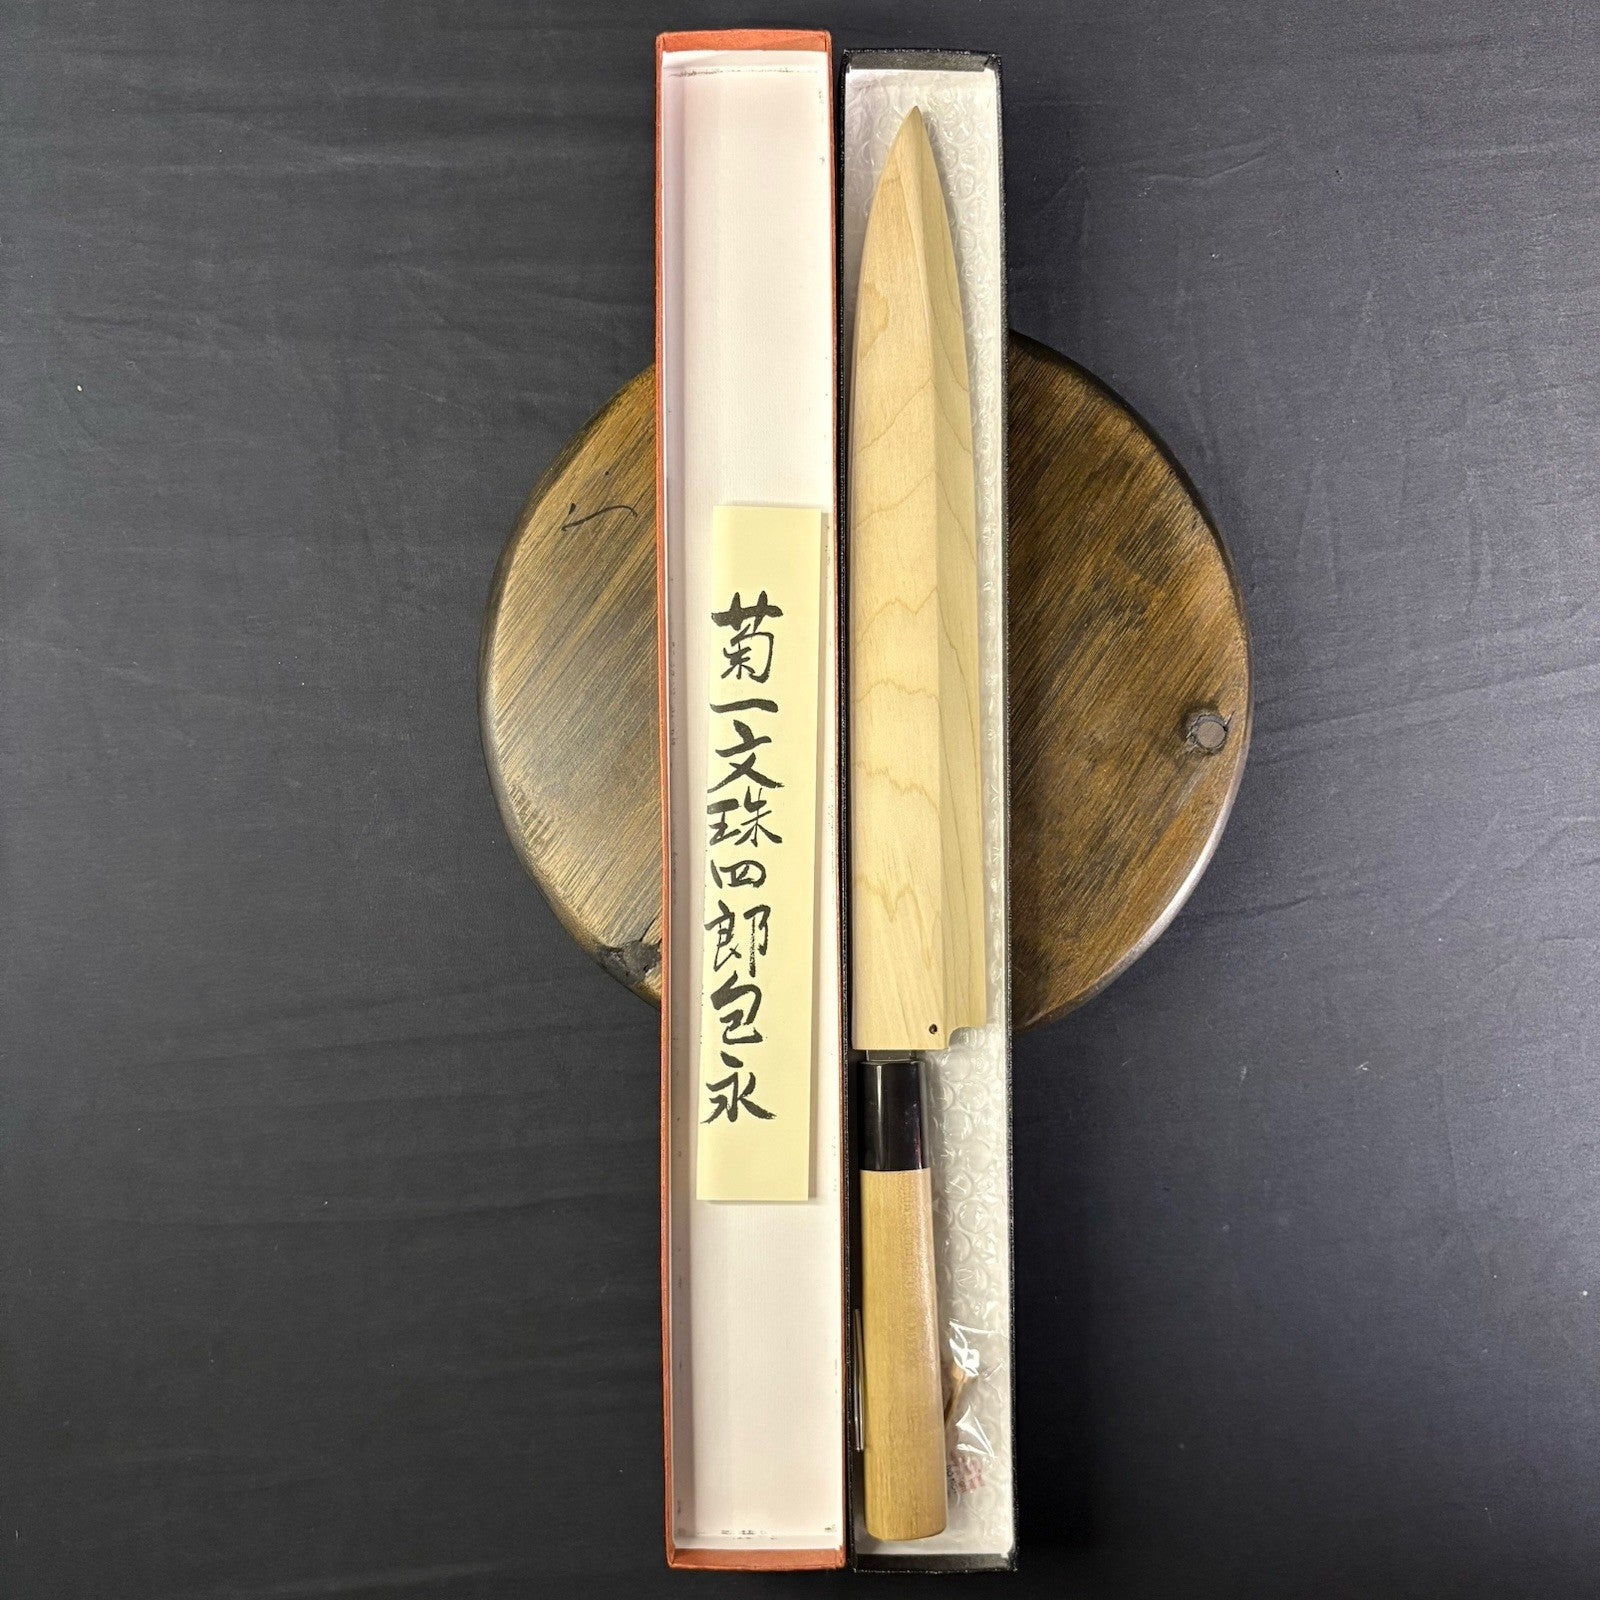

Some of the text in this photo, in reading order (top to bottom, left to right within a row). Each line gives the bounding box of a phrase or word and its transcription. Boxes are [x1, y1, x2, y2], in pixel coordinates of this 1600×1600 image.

[702, 590, 784, 1124] 菊一文珠四郎包永
